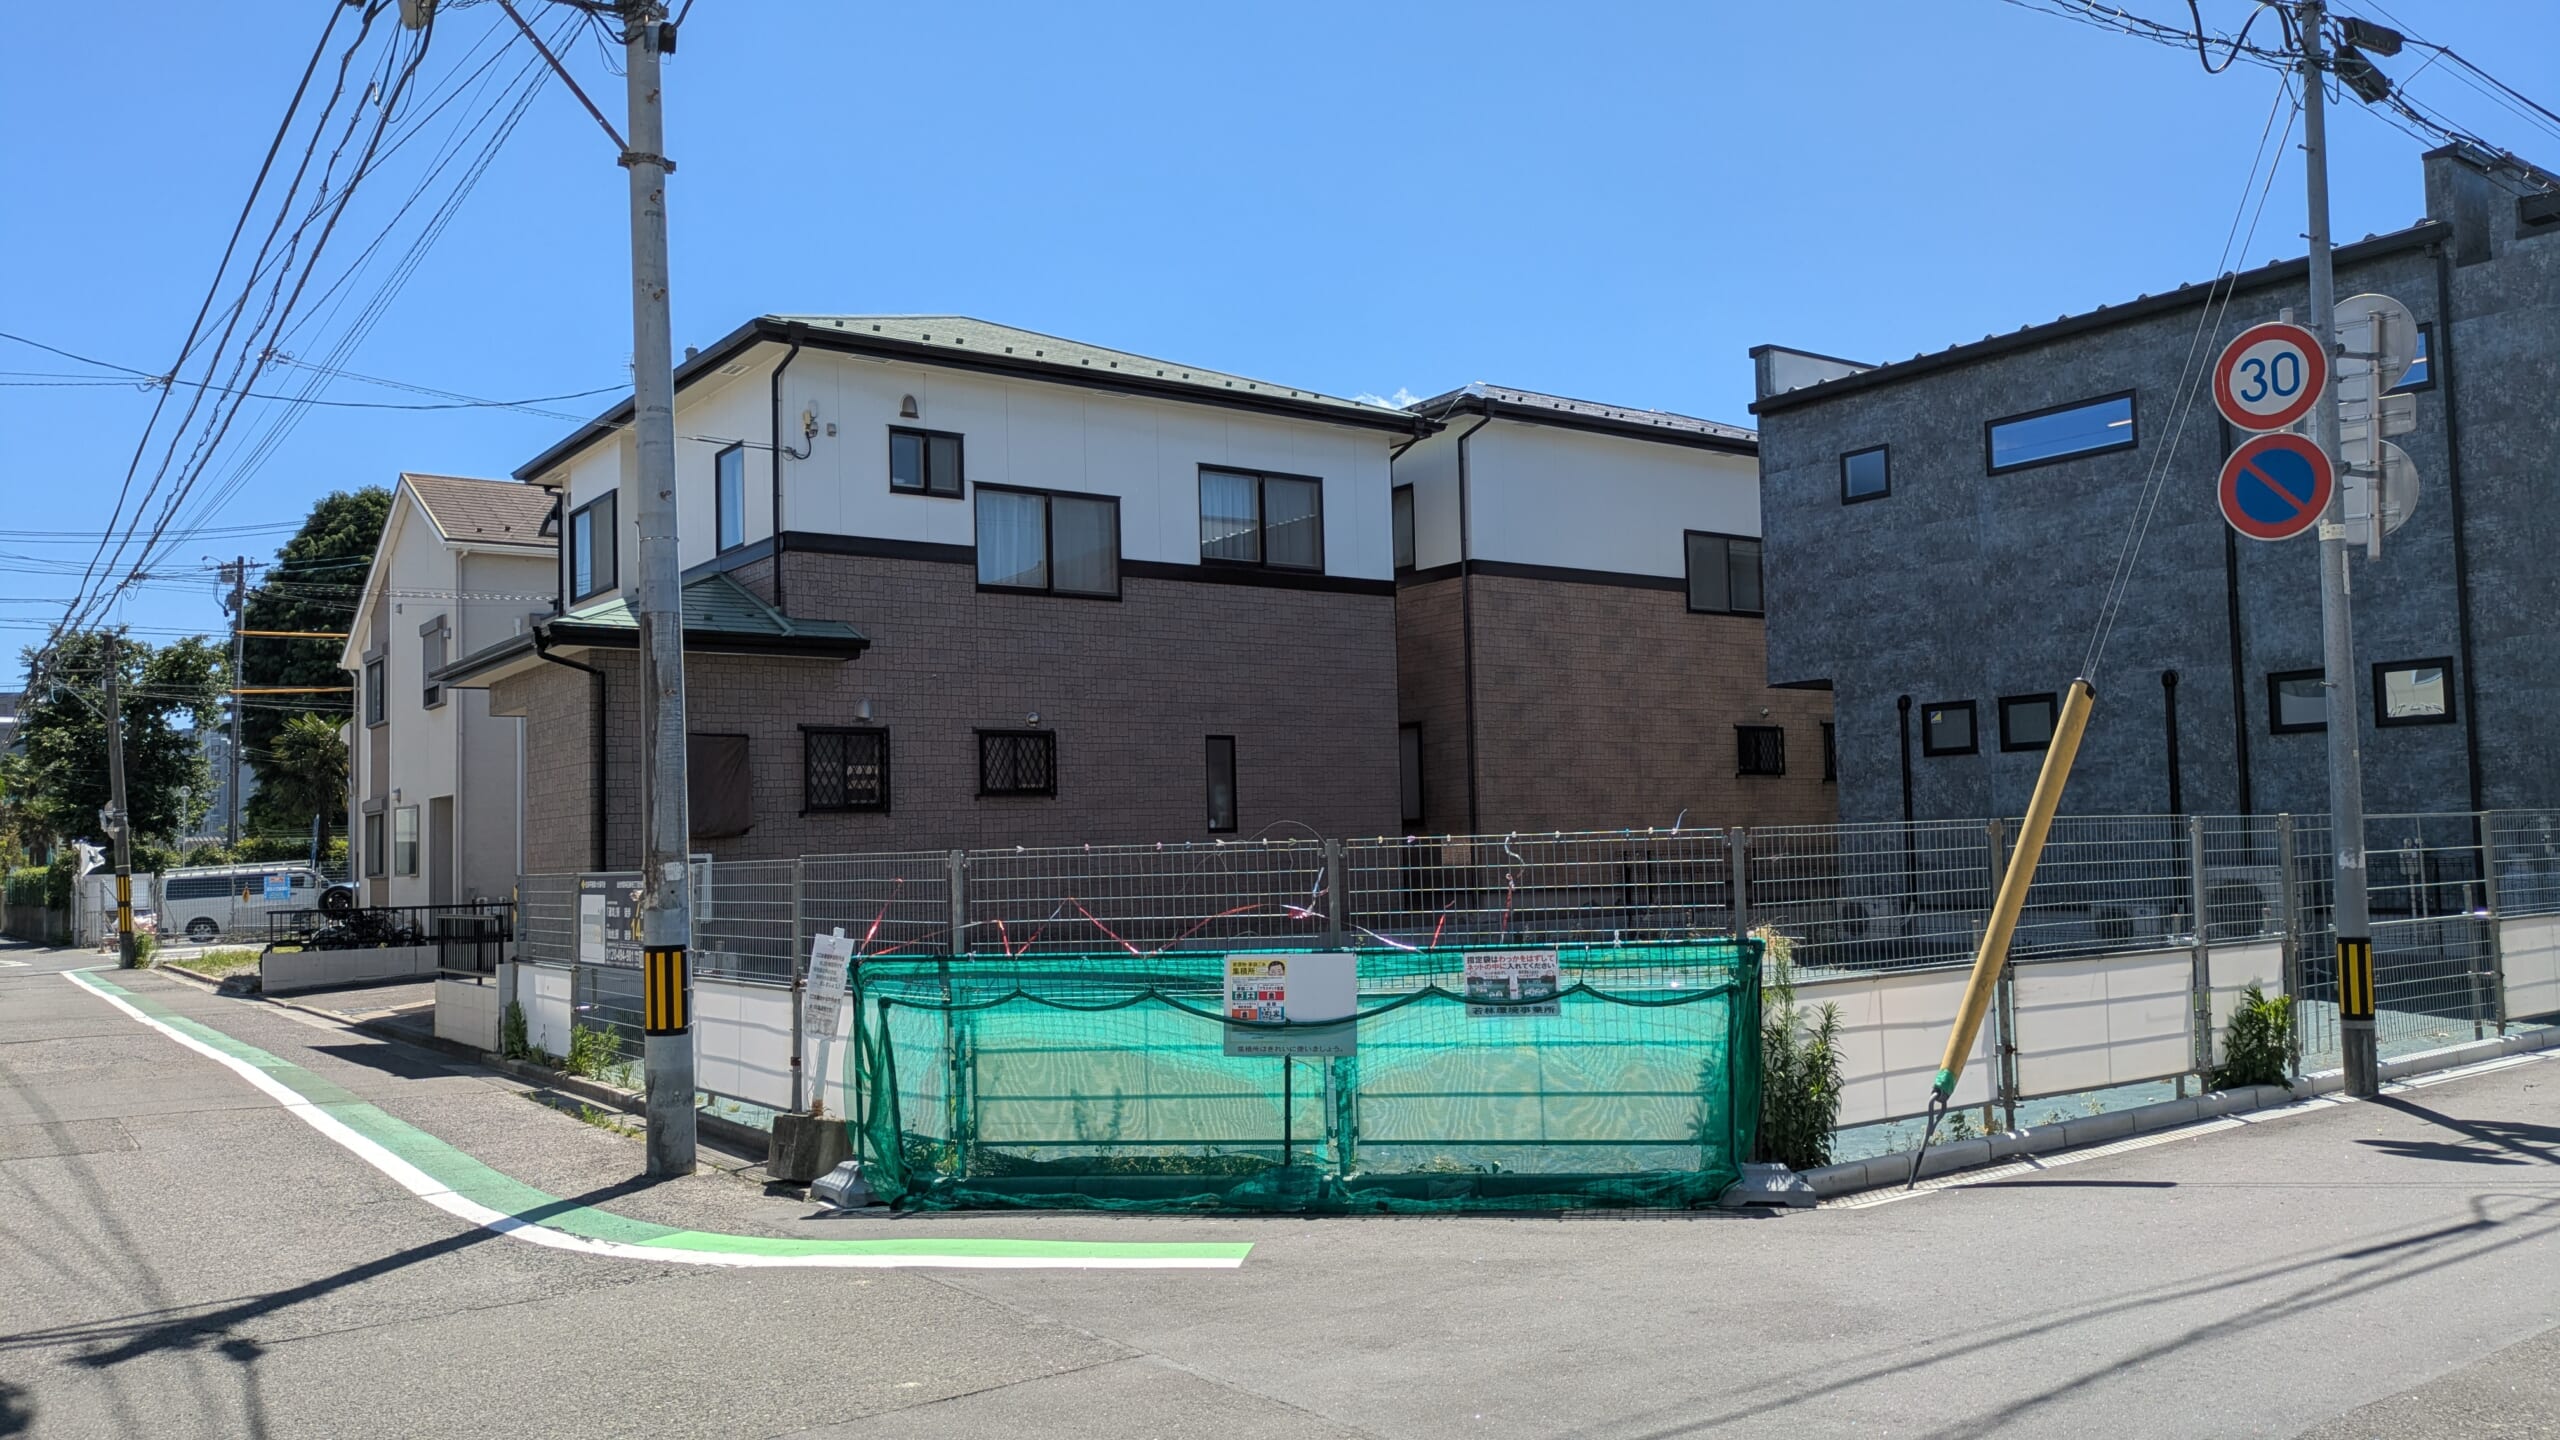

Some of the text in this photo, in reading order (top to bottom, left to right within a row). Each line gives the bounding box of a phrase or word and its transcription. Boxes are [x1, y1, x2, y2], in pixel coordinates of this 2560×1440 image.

[2240, 352, 2300, 402] 30
[1467, 955, 1554, 963] 指定袋はわっかをはずして
[1232, 967, 1256, 975] 集積所
[1472, 1006, 1555, 1014] 若林環境事業所
